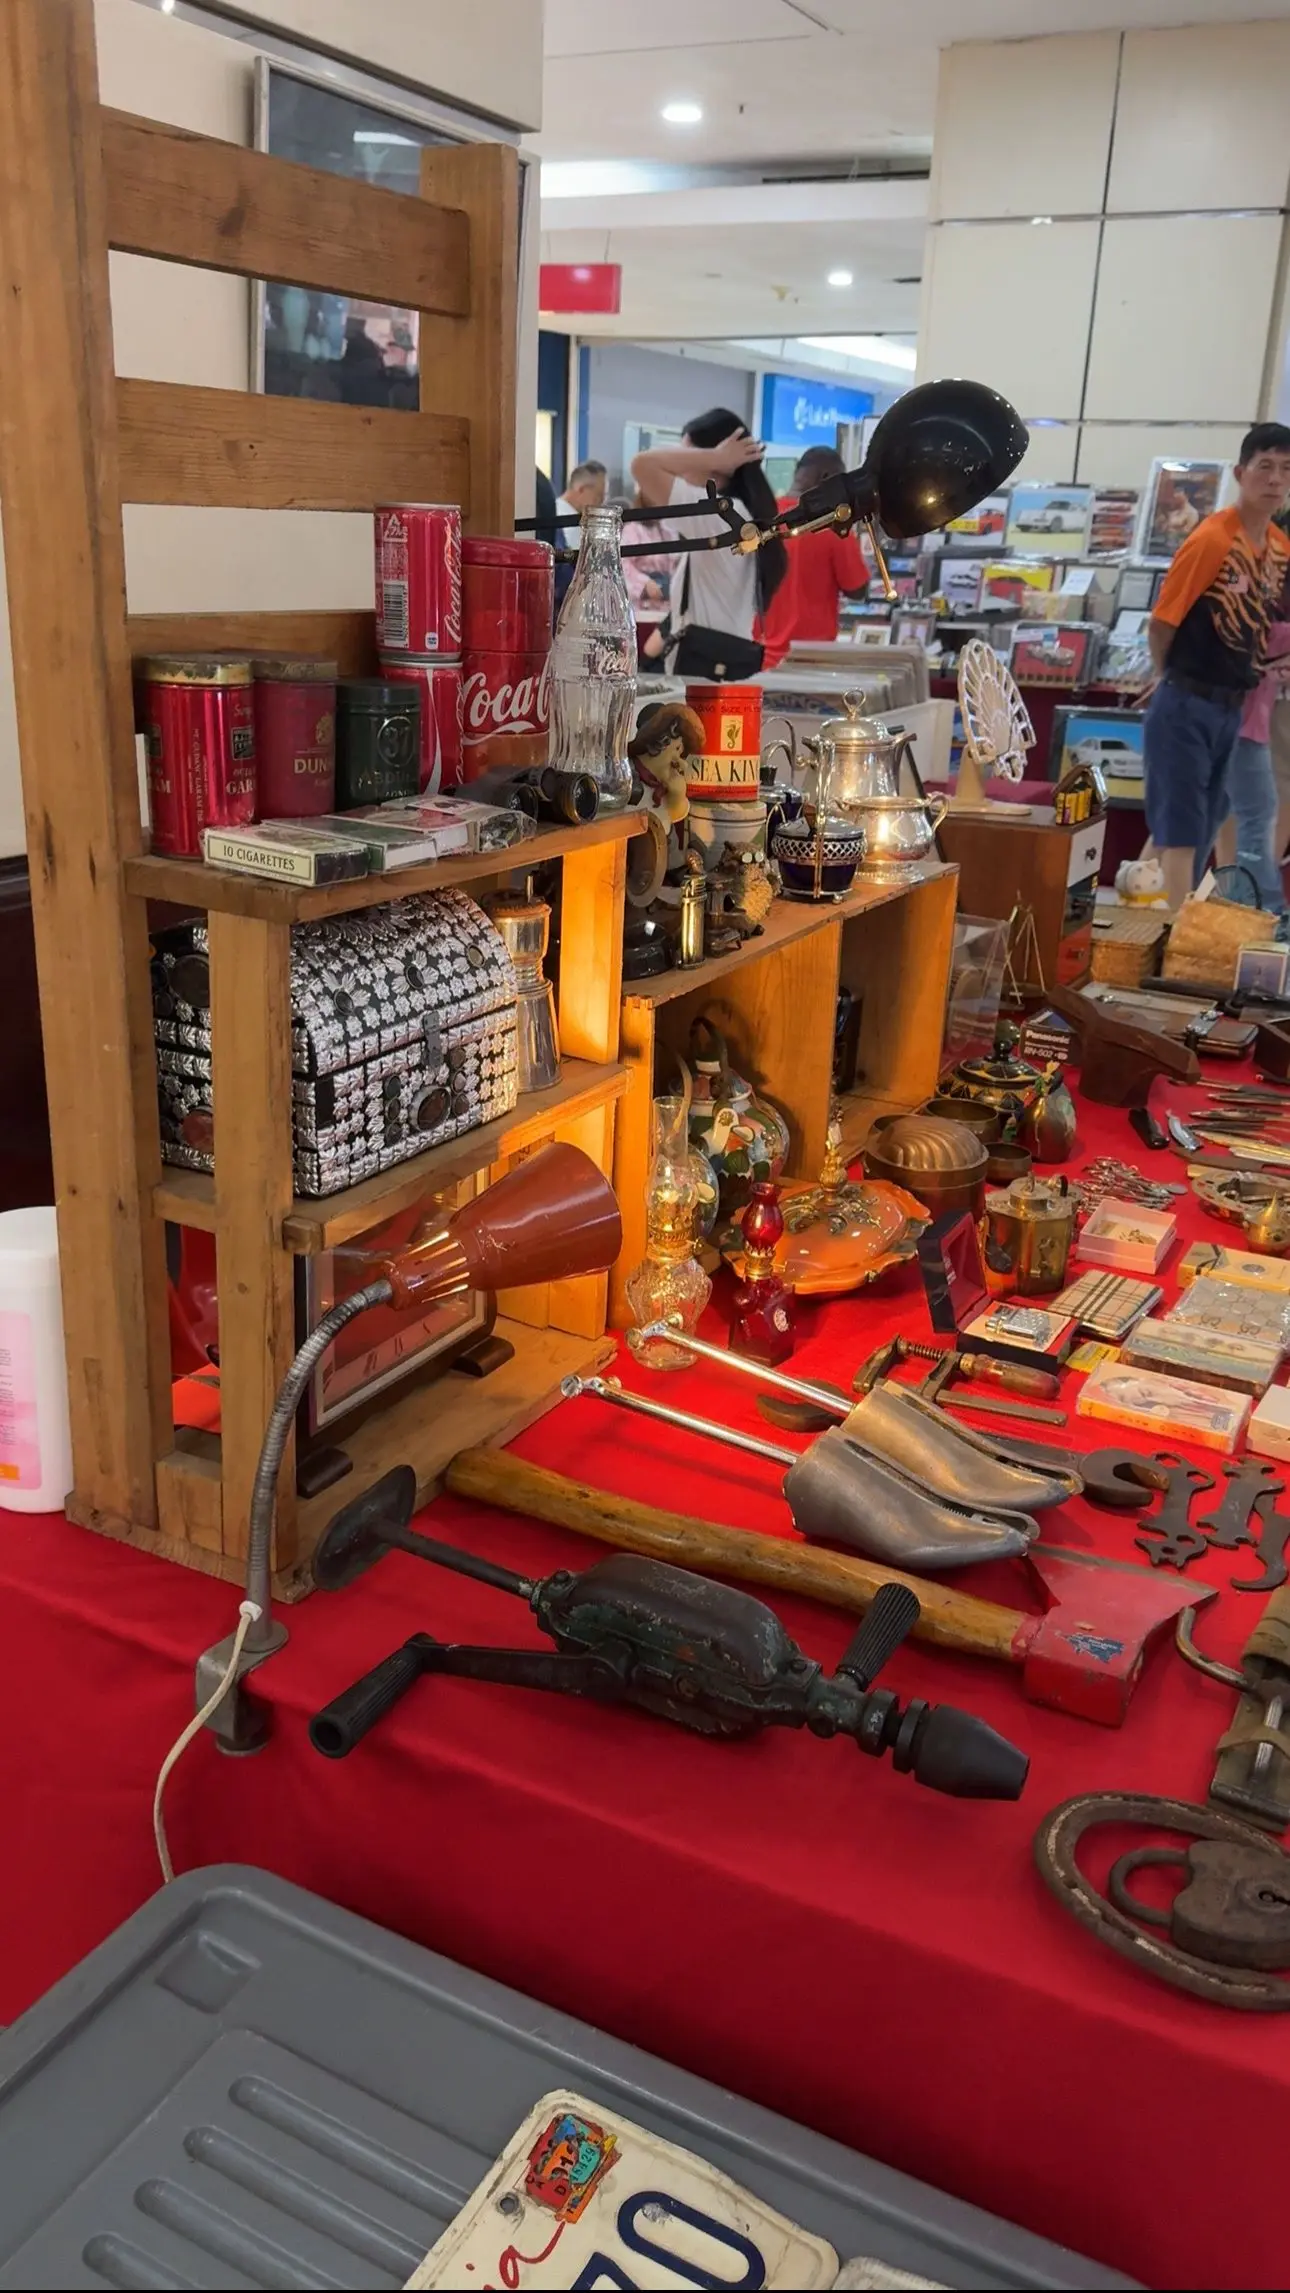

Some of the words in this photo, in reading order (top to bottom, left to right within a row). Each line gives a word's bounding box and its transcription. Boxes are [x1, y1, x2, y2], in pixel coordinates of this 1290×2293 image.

[691, 759, 722, 783] SEA
[223, 844, 234, 858] 10
[236, 847, 295, 871] CIGARETTES
